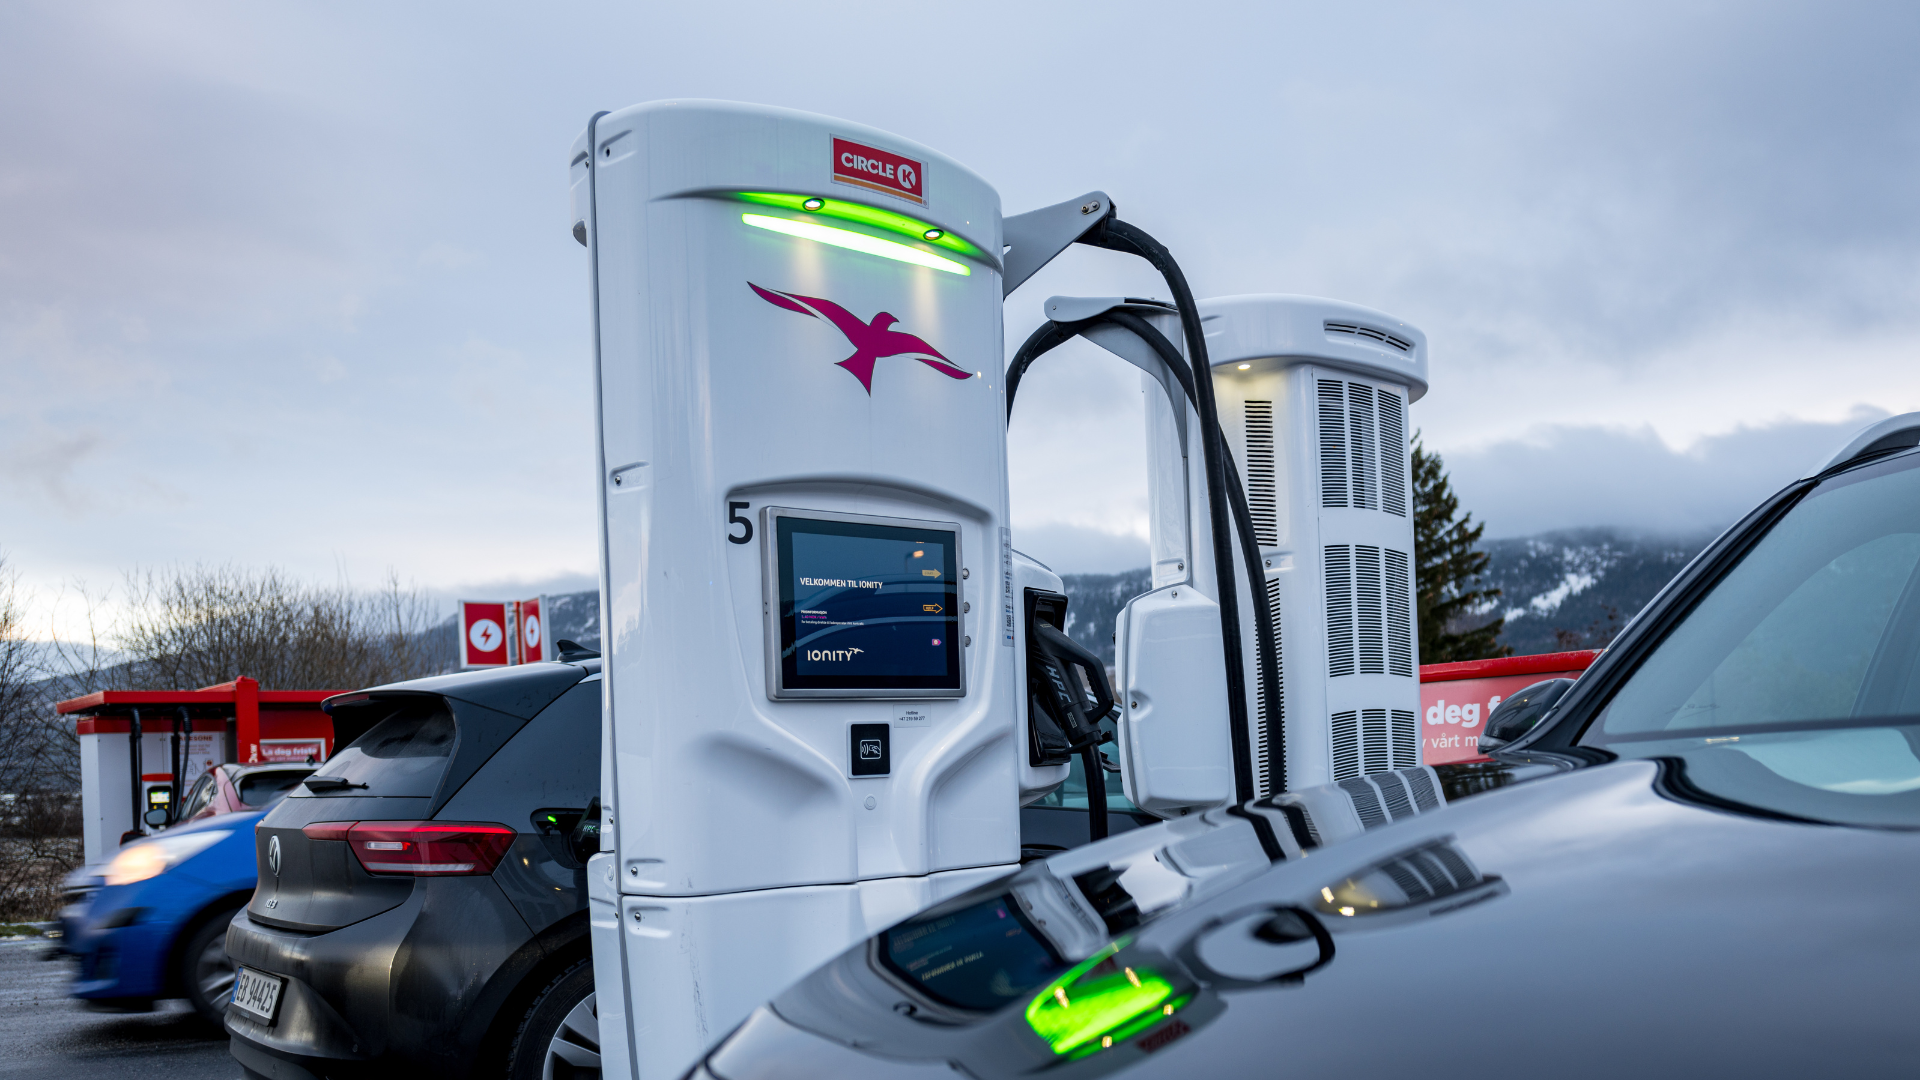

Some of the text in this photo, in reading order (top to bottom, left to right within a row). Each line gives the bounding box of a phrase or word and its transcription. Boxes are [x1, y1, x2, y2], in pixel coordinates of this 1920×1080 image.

[841, 152, 916, 188] CIRCLE K
[728, 501, 753, 544] 5
[800, 577, 883, 589] VELKOMMEN TIL IONITY
[807, 650, 853, 661] IONITY
[1046, 665, 1071, 703] HPC
[1426, 699, 1480, 728] deg
[274, 748, 291, 756] deg
[1431, 733, 1460, 748] vårt
[236, 974, 277, 1013] EB 94425
